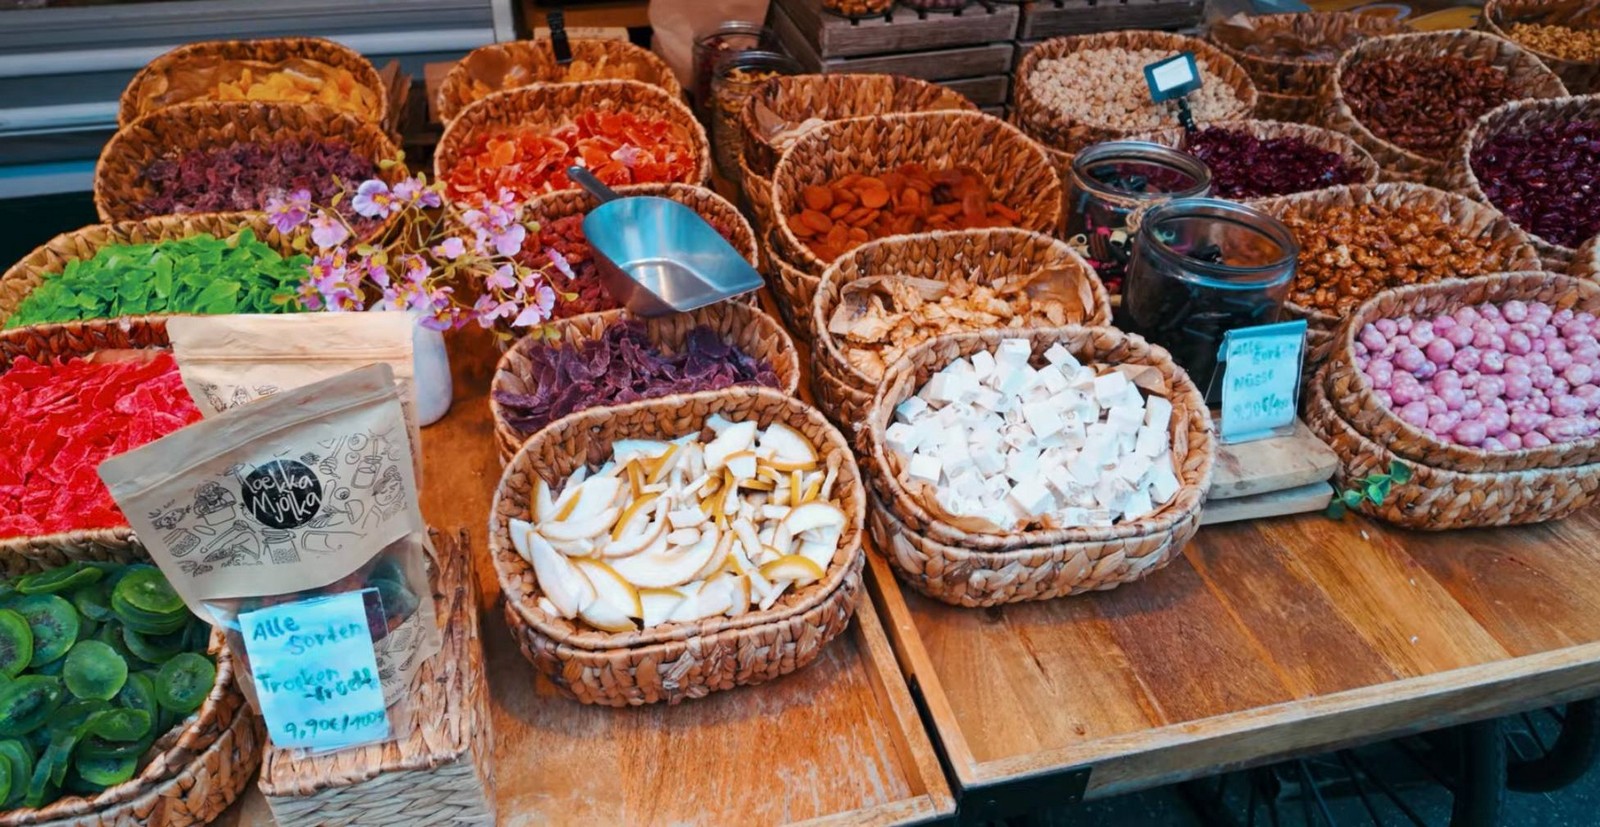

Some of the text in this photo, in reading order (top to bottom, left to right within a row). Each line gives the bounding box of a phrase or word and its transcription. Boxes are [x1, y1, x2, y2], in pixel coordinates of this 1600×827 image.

[252, 489, 322, 523] Mjölka
[252, 616, 300, 641] Alle
[288, 623, 363, 655] Sorten
